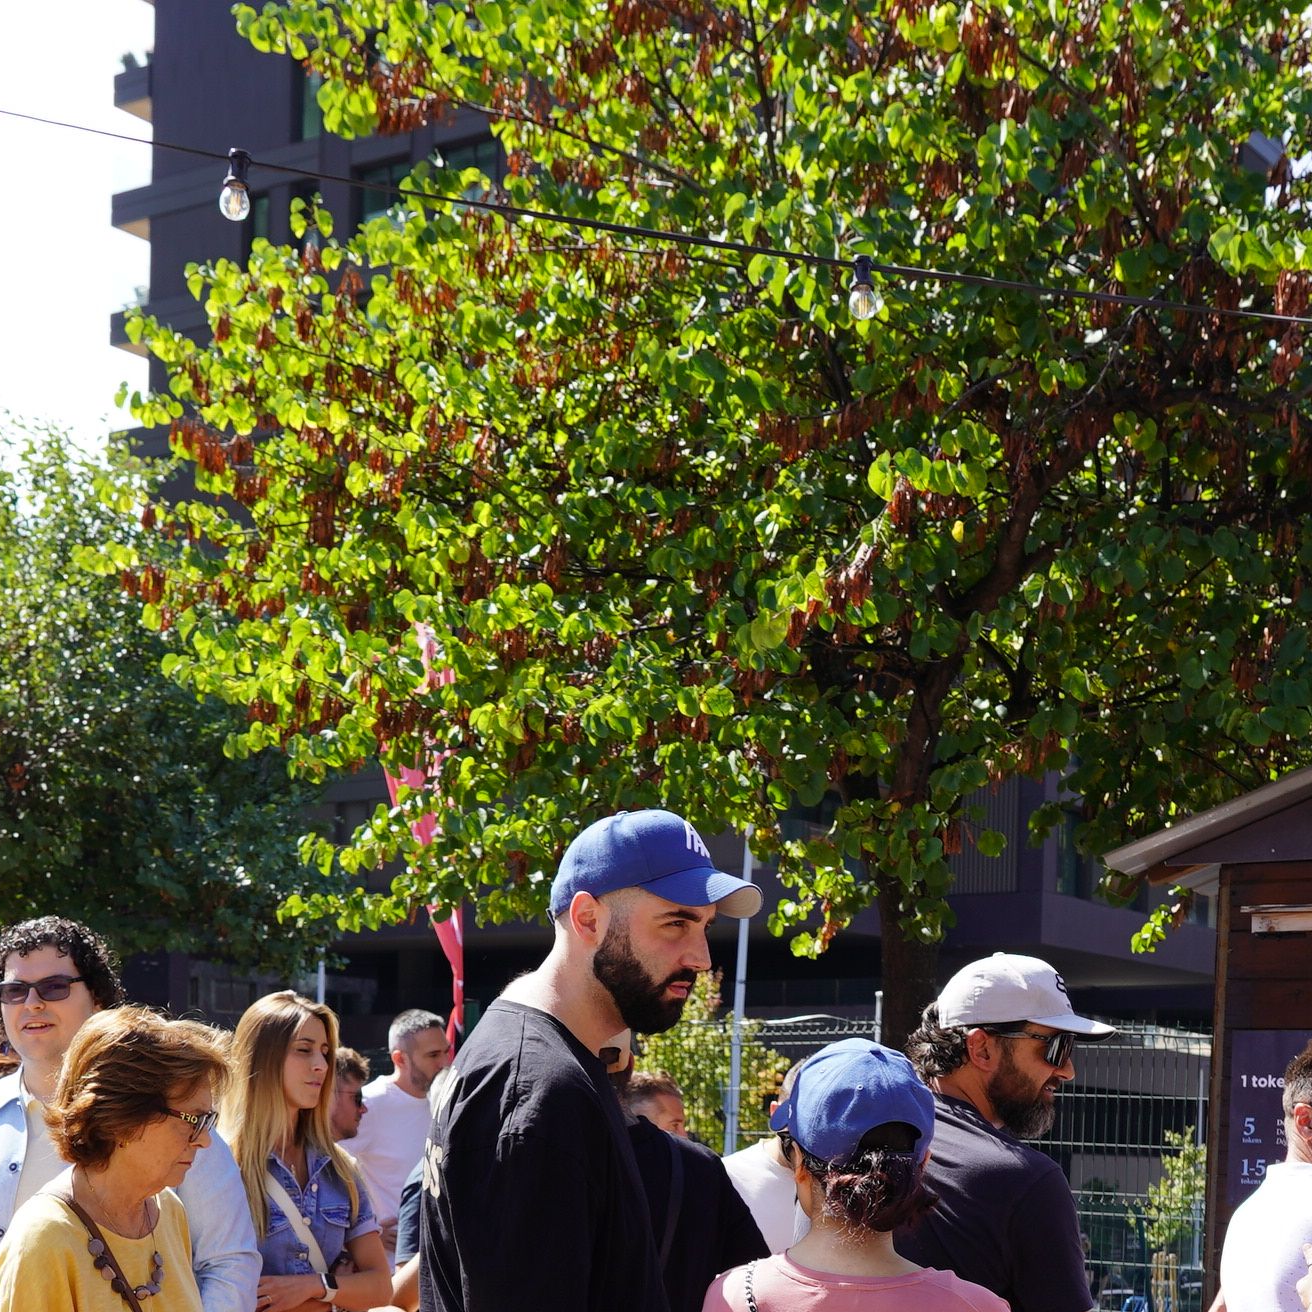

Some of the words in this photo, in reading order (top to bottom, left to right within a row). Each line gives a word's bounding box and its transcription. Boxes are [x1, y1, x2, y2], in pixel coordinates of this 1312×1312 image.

[1240, 1074, 1248, 1088] 1
[1252, 1074, 1285, 1088] toke
[1243, 1117, 1255, 1136] 5
[1241, 1158, 1266, 1177] 1-5
